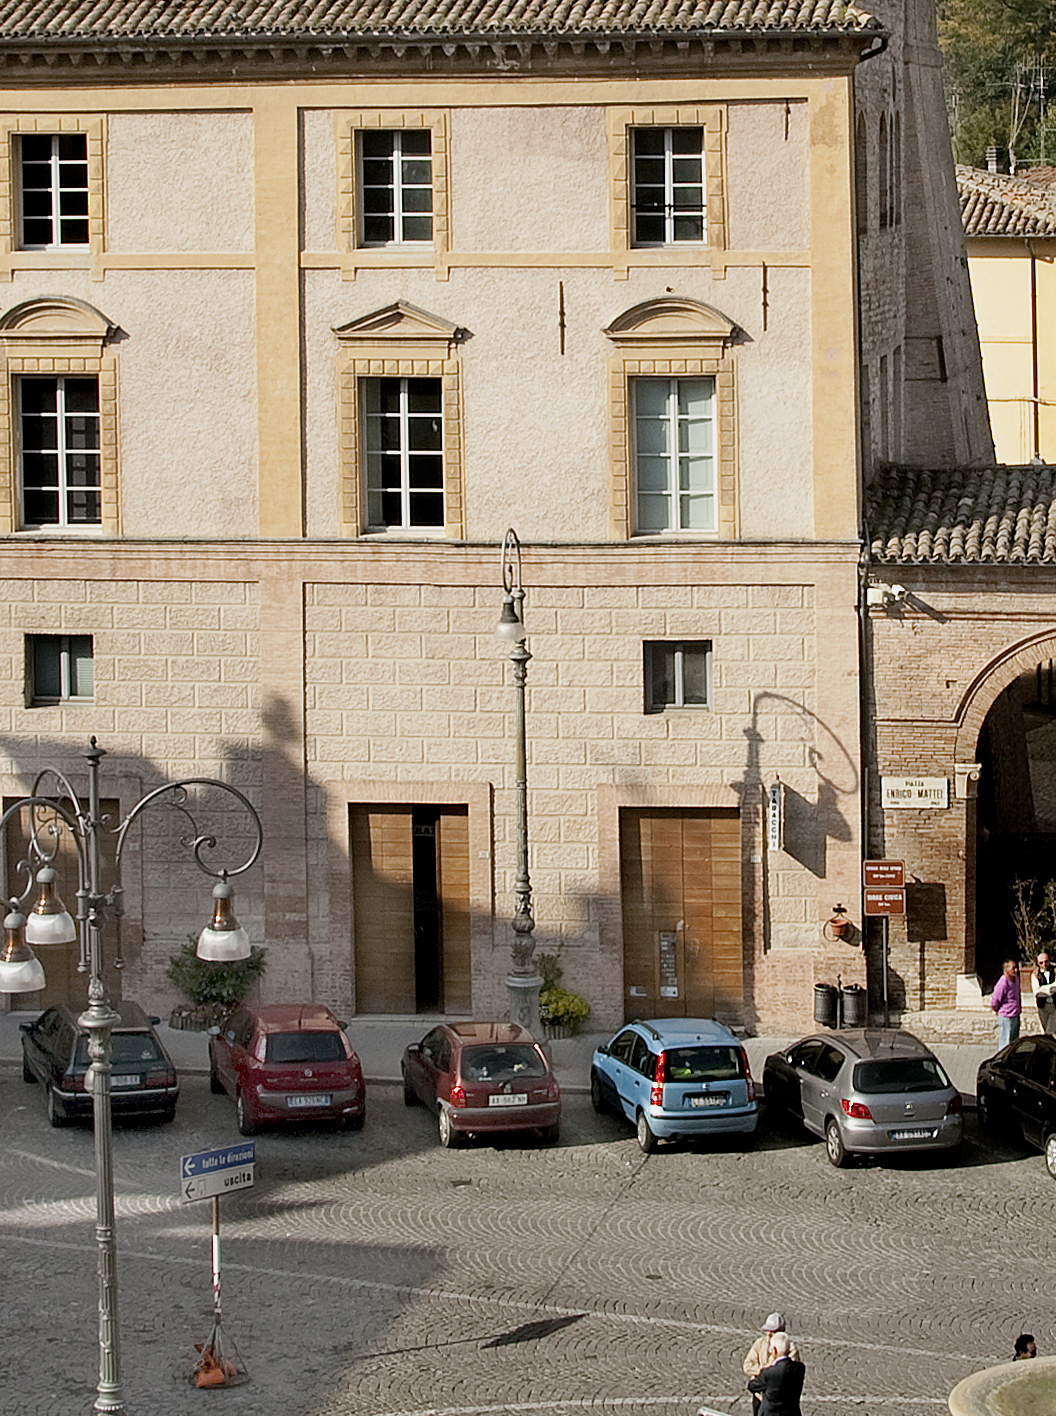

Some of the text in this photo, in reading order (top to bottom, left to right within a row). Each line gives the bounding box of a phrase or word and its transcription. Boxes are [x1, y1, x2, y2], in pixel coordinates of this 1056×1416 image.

[886, 789, 943, 799] ENRICO MATTEI
[201, 1147, 254, 1169] tutte le direzioni
[224, 1171, 252, 1187] uscita
